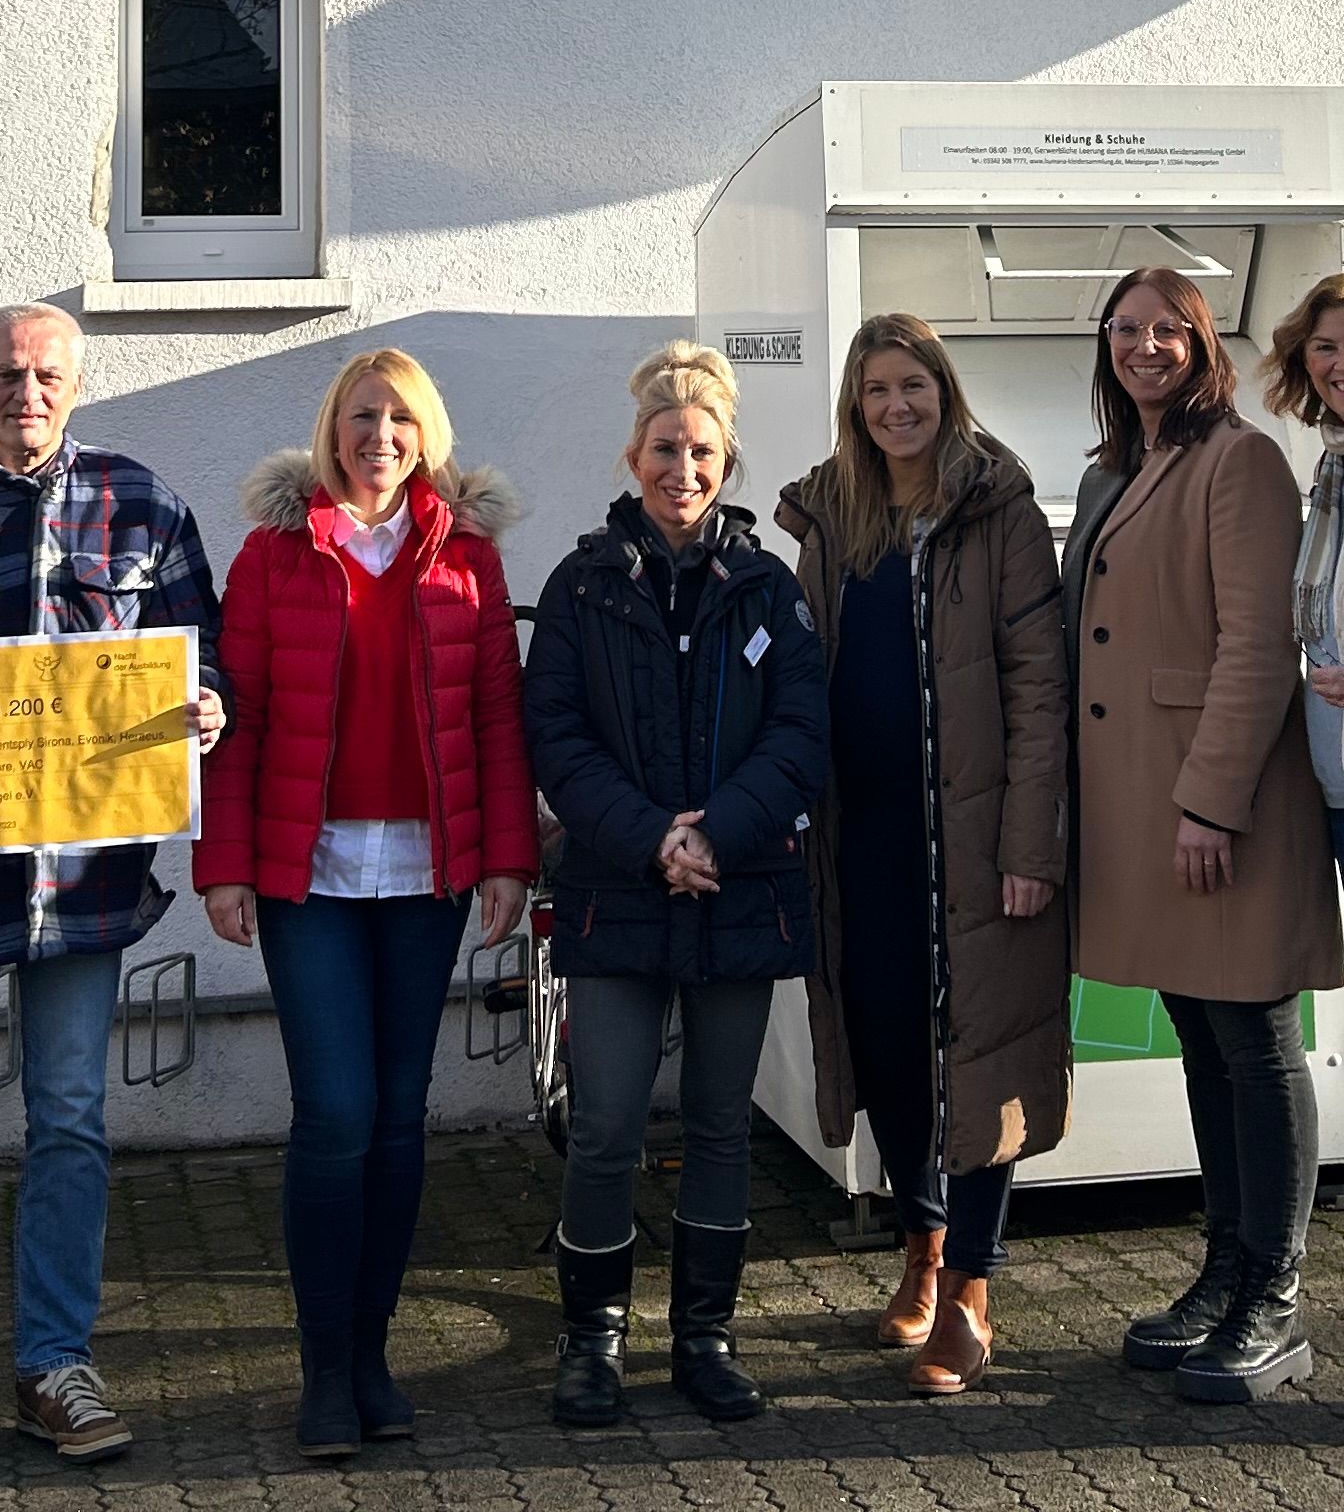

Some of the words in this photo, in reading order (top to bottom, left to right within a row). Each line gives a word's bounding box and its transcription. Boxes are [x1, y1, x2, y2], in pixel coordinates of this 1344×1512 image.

[1044, 134, 1092, 146] Kleidung
[1095, 134, 1104, 144] &
[1107, 134, 1145, 145] Schuhe
[725, 336, 764, 360] KLEIDUNG
[766, 339, 771, 357] &
[772, 335, 801, 360] SCHUHE
[51, 697, 63, 714] €
[78, 734, 116, 745] Evonik,
[19, 759, 43, 771] VAC
